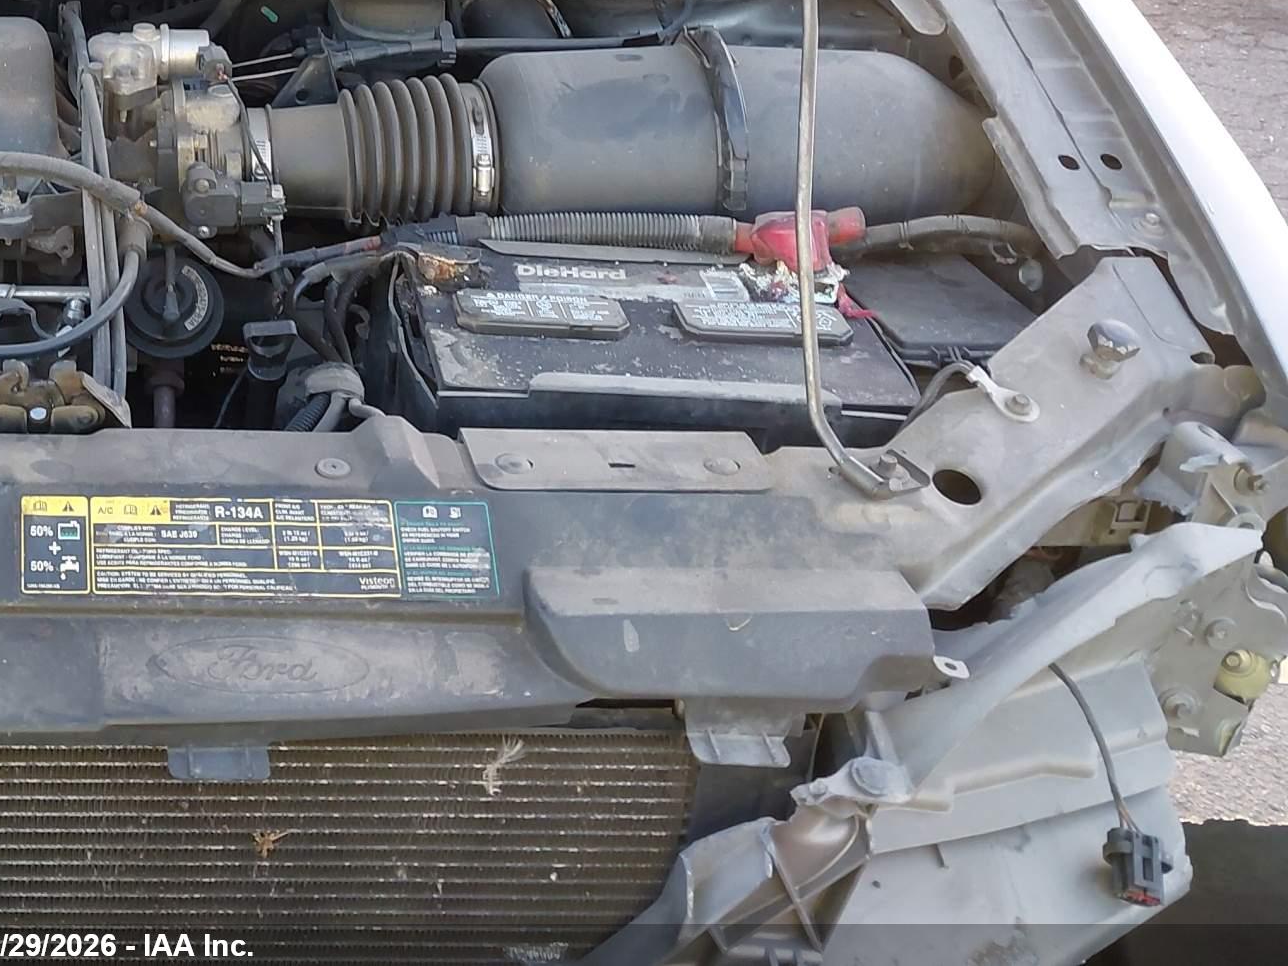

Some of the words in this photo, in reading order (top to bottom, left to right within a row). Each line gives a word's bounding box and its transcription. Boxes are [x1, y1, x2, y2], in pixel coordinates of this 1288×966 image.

[516, 263, 628, 281] DieHard
[97, 506, 114, 515] A/C
[214, 505, 264, 519] R-134A
[30, 525, 54, 537] 50%
[161, 530, 178, 538] SAE
[30, 560, 54, 572] 50%
[359, 577, 395, 588] Visteon
[207, 643, 319, 681] Ford
